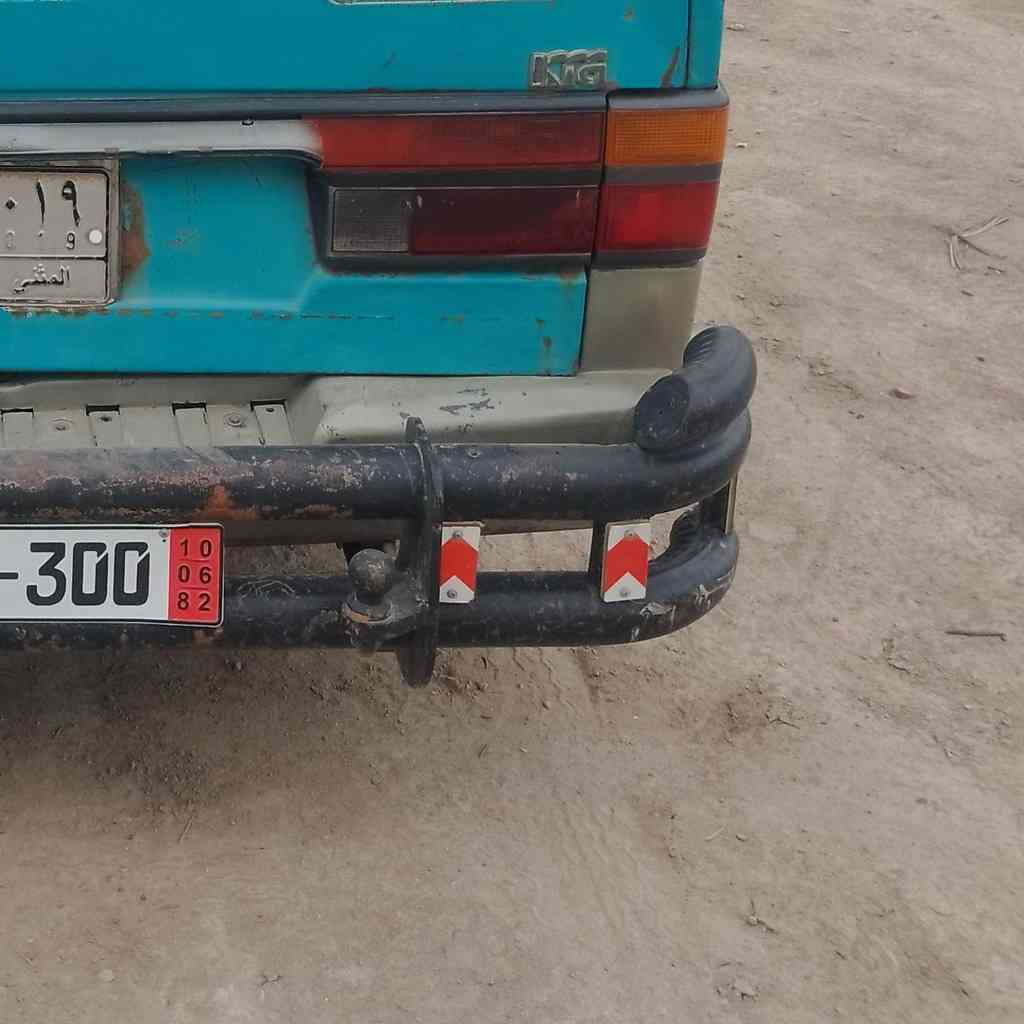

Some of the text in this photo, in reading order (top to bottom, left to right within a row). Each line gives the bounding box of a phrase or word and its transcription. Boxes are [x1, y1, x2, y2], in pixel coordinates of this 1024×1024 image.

[179, 538, 213, 558] 10
[177, 564, 212, 585] 06
[177, 591, 211, 612] 82
